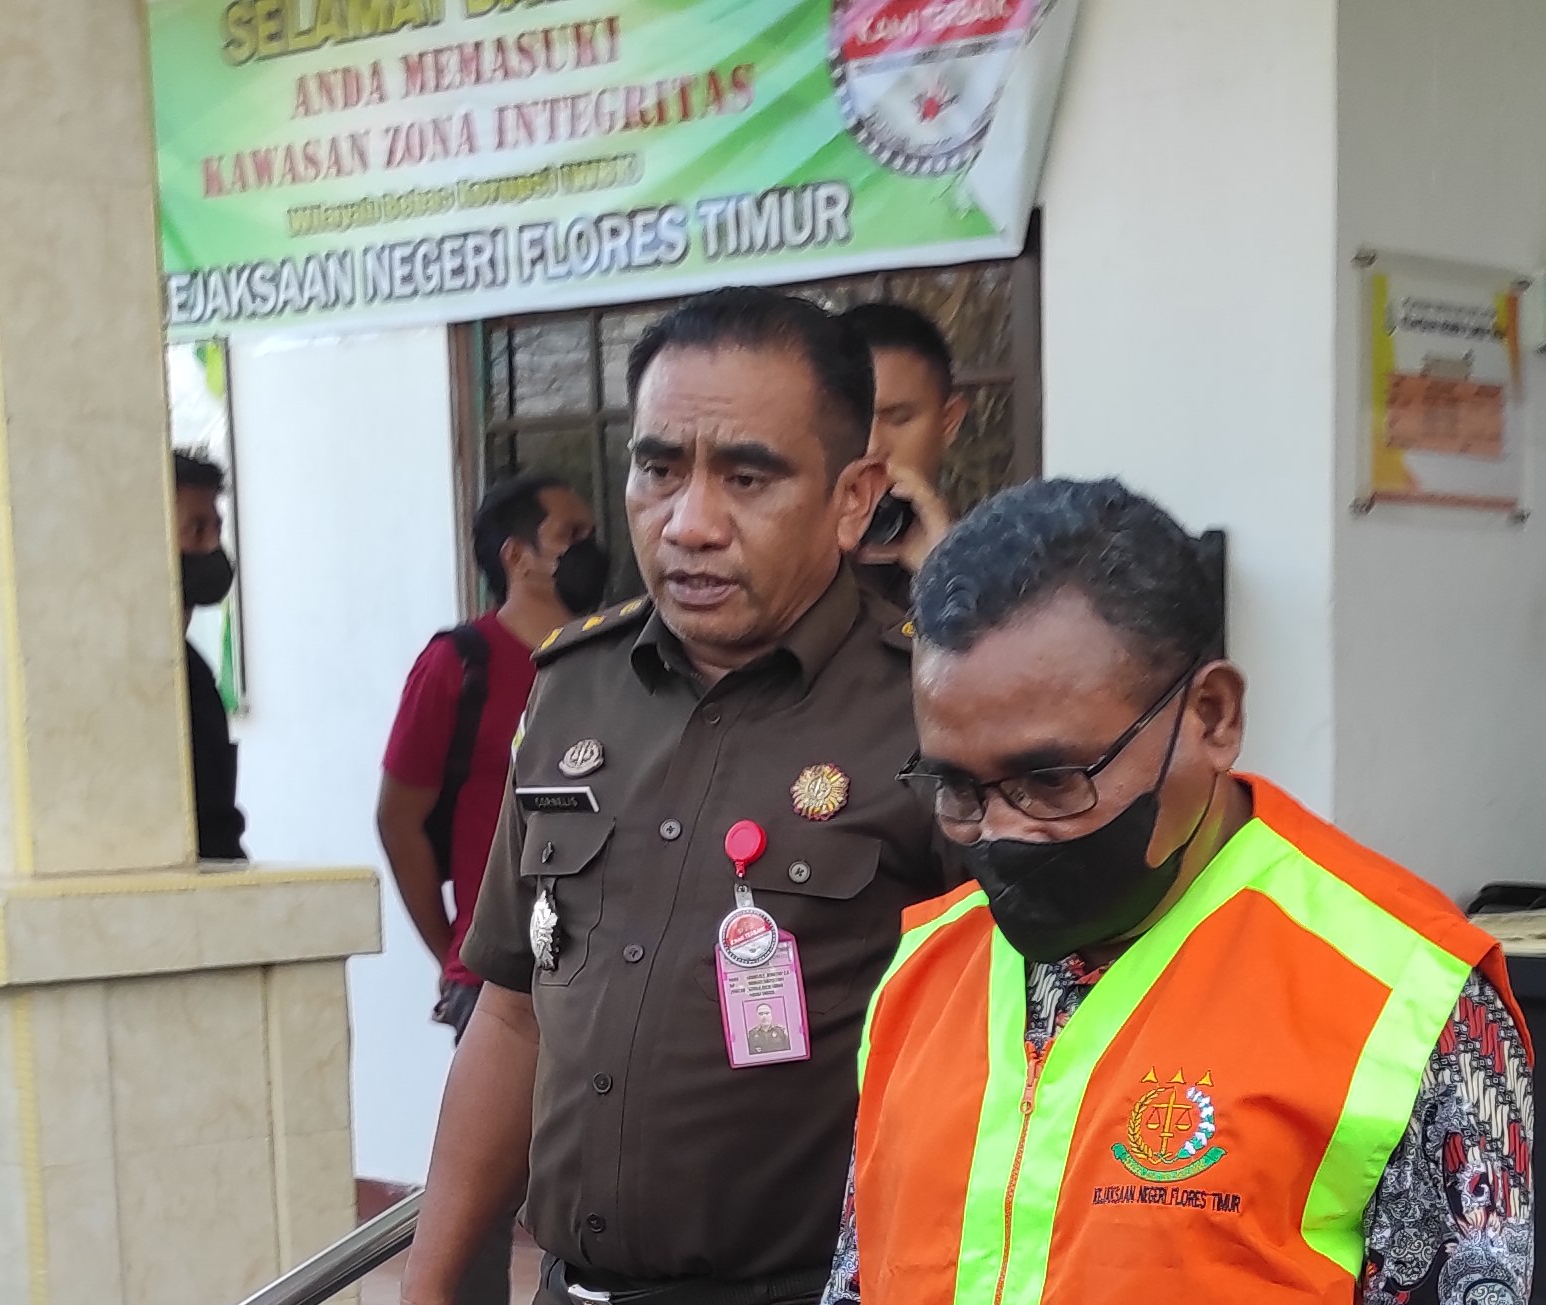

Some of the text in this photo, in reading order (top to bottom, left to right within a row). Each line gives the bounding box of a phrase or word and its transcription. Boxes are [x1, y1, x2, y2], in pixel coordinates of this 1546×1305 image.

[293, 15, 621, 118] ANDA MEMASUKI
[203, 64, 755, 198] KAWASAN ZONA INTEGRITAS
[365, 228, 509, 302] NEGERI
[519, 205, 691, 283] FLORES
[696, 180, 853, 259] TIMUR
[1171, 1187, 1207, 1209] FLORES
[1211, 1192, 1241, 1213] TIMUR
